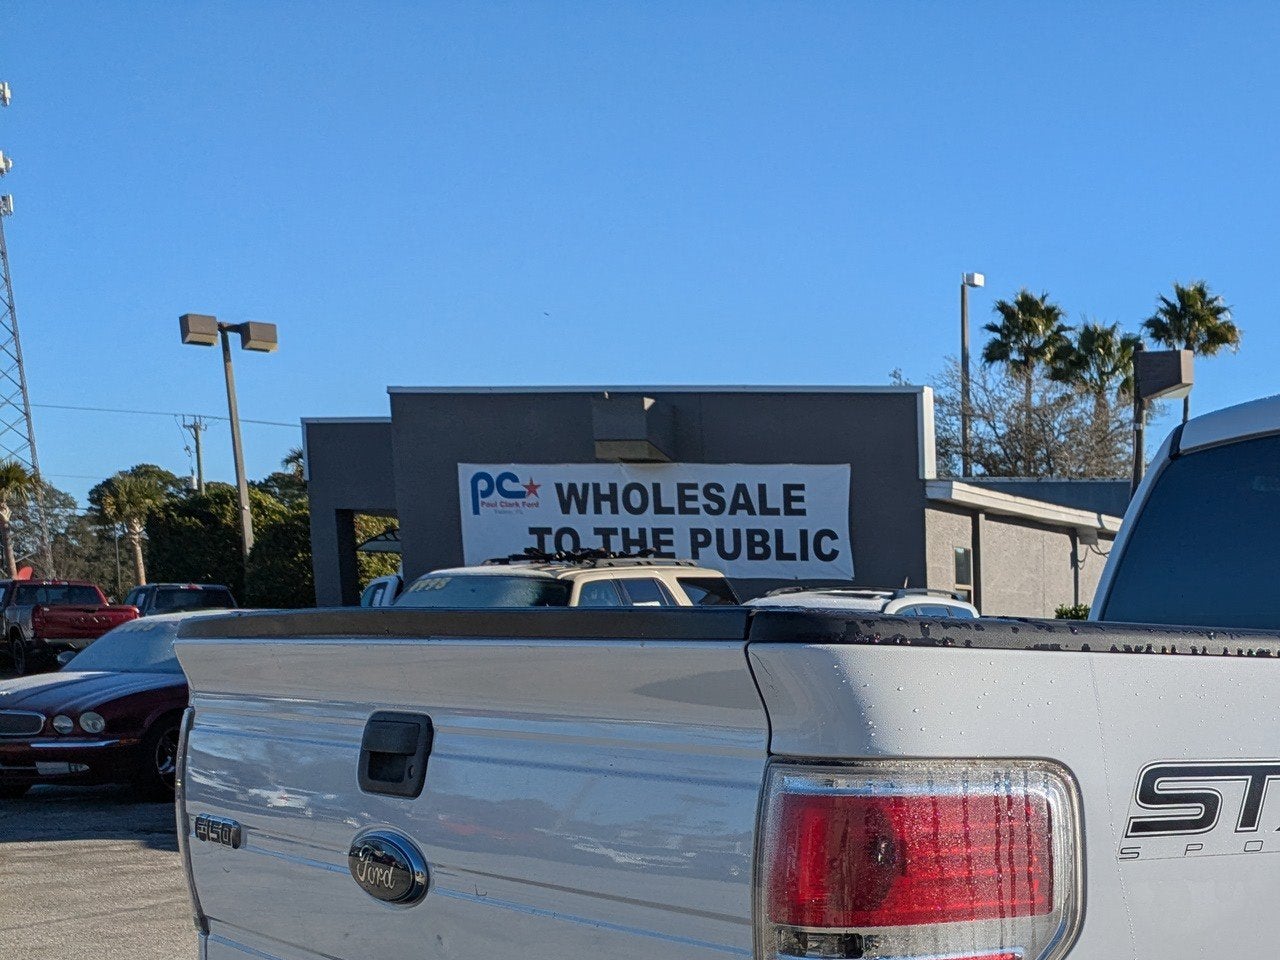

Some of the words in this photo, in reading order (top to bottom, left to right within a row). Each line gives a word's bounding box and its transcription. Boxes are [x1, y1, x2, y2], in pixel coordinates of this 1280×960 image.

[554, 482, 807, 516] WHOLESALE
[528, 526, 581, 557] TO
[593, 527, 676, 559] THE
[689, 528, 840, 562] PUBLIC
[356, 845, 397, 890] Ford
